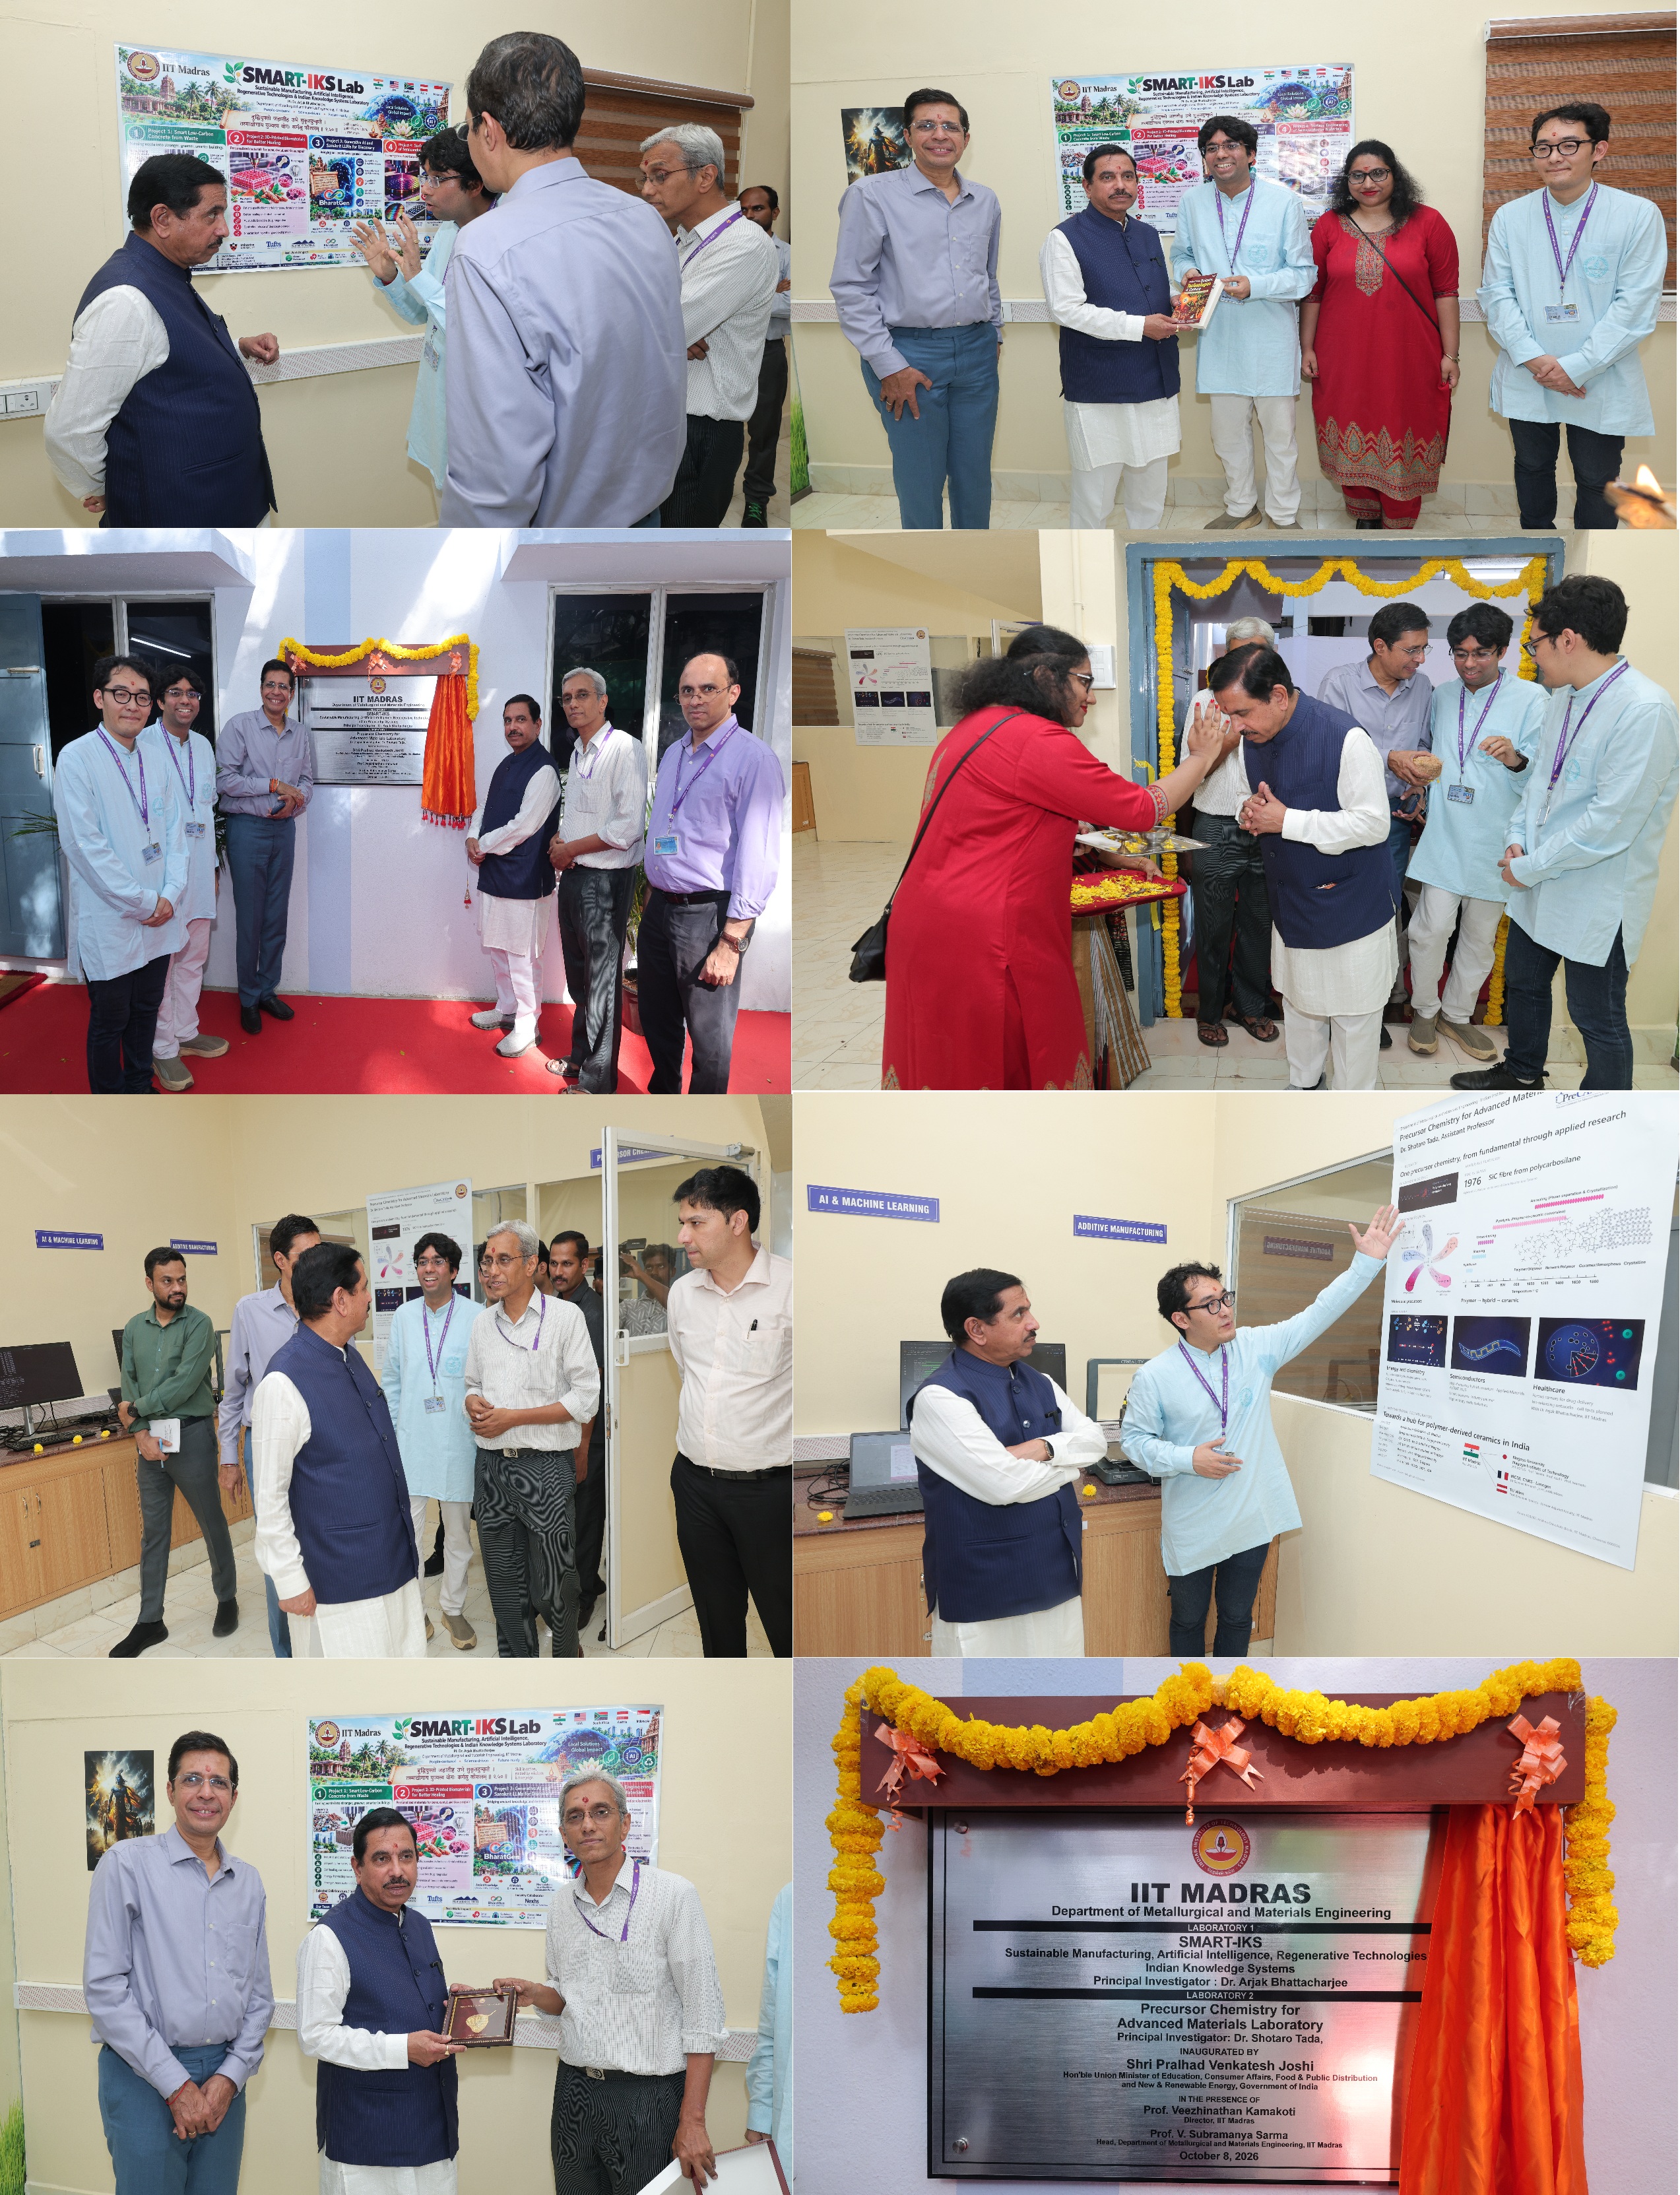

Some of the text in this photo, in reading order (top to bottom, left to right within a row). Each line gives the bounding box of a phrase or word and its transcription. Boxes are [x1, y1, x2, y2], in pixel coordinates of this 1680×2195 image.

[162, 63, 210, 77] IIT Madras
[242, 66, 364, 94] SMART-IKS Lab
[1142, 75, 1254, 92] SMART-IKS Lab
[1400, 1127, 1427, 1141] Precursor
[1428, 1115, 1460, 1132] Chemistry
[1462, 1111, 1471, 1121] for
[1473, 1097, 1510, 1117] Advanced
[1407, 1140, 1426, 1151] Shotaro
[1427, 1136, 1440, 1144] Tada,
[1440, 1127, 1466, 1140] Assistant
[1467, 1118, 1495, 1132] Professor
[1410, 1163, 1433, 1177] precursor
[1434, 1156, 1462, 1168] chemistry,
[1463, 1151, 1477, 1160] from
[1479, 1138, 1521, 1156] fundamental
[1523, 1130, 1553, 1144] through
[1555, 1121, 1586, 1136] applied
[1588, 1110, 1627, 1127] research
[1464, 1176, 1481, 1188] 1976
[1499, 1169, 1512, 1179] fibre
[1514, 1166, 1528, 1175] from
[1530, 1155, 1581, 1173] polycarbosilane
[819, 1195, 929, 1214] AI & MACHINE LEARNING
[1078, 1222, 1163, 1237] ADDITIVE MANUFACTURING
[1450, 1373, 1485, 1383] Semiconductors
[1533, 1384, 1565, 1394] Healthcare
[1384, 1412, 1402, 1421] Towards
[1406, 1416, 1417, 1424] hub
[1426, 1421, 1472, 1437] polymer-derived
[1473, 1433, 1501, 1445] ceramics
[1502, 1438, 1510, 1447] in
[1511, 1440, 1530, 1451] India
[410, 1718, 540, 1738] SMART-IKS Lab
[1131, 1883, 1311, 1903] IIT MADRAS
[1052, 1905, 1391, 1920] Department of Metallurgical and Materials Engineering
[1179, 1936, 1262, 1948] SMART-IKS
[1005, 1948, 1427, 1962] Sustainable Manufacturing, Artificial Intelligence, Regenerative Technologies
[1093, 1976, 1348, 1989] Principal Investigator Dr. Arjak Bhattacharjee
[1142, 2003, 1301, 2017] Precursor Chemistry for
[1117, 2018, 1323, 2033] Advanced Materials Laboratory
[1117, 2032, 1163, 2043] Principal
[1166, 2033, 1231, 2044] Investigator:
[1251, 2034, 1293, 2043] Shotaro
[1295, 2035, 1323, 2044] Tada,
[1126, 2058, 1314, 2071] Shri Pralhad Venkatesh Joshi
[1144, 2105, 1295, 2116] Prof. Veezhinathan Kamakoti
[1189, 2130, 1253, 2140] Subramanya
[1256, 2131, 1288, 2140] Sarma
[1179, 2151, 1258, 2161] October 8, 2026
